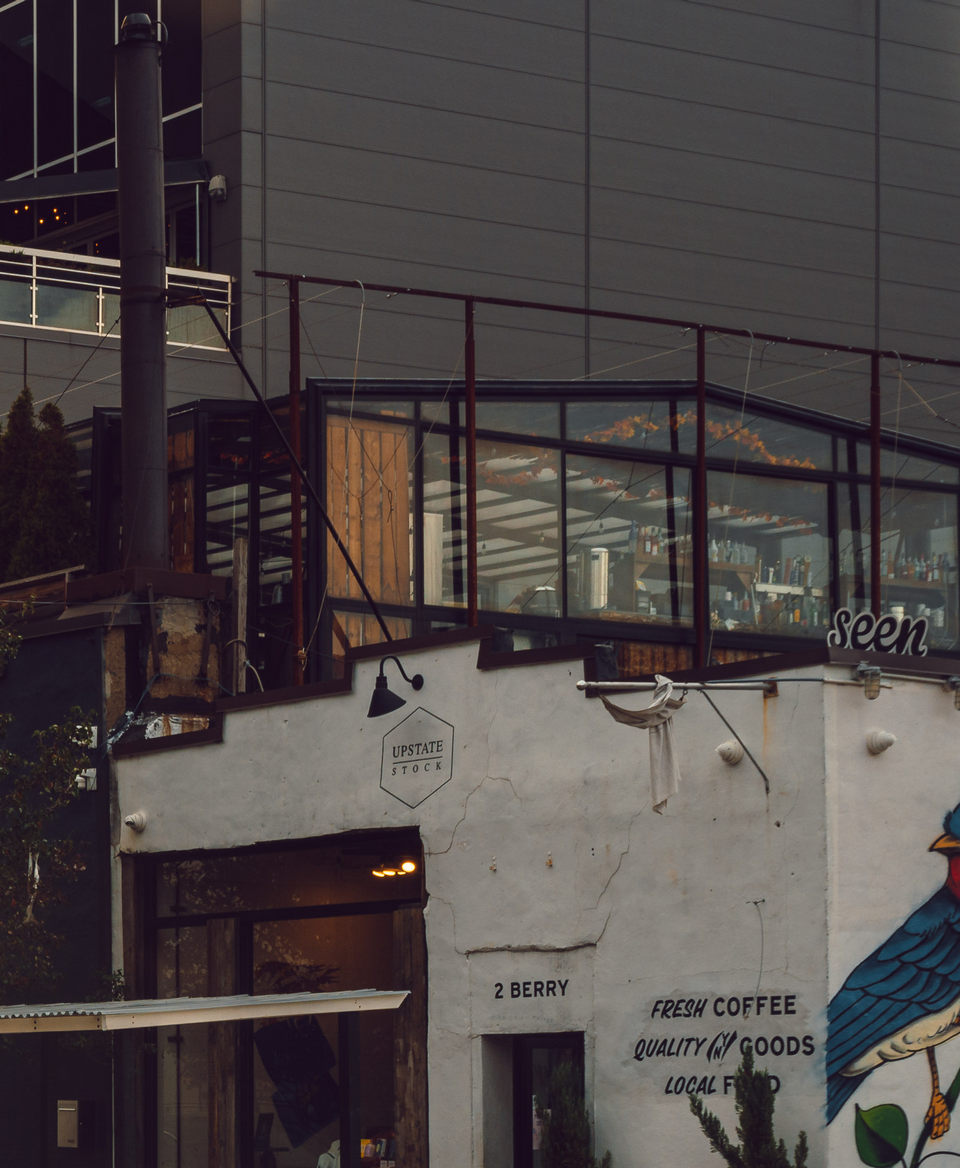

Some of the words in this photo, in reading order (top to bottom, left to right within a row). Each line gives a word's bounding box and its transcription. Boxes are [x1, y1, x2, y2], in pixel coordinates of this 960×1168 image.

[827, 607, 928, 657] seen
[392, 740, 444, 758] UPSTATE
[391, 762, 442, 776] STOCK
[494, 982, 504, 999] 2
[510, 979, 570, 999] BERRY
[651, 998, 708, 1019] FRESH
[713, 995, 797, 1017] COFFEE
[633, 1037, 707, 1062] QUALITY
[740, 1035, 816, 1057] GOODS
[665, 1075, 717, 1095] LOCAL
[723, 1075, 781, 1095] FD
